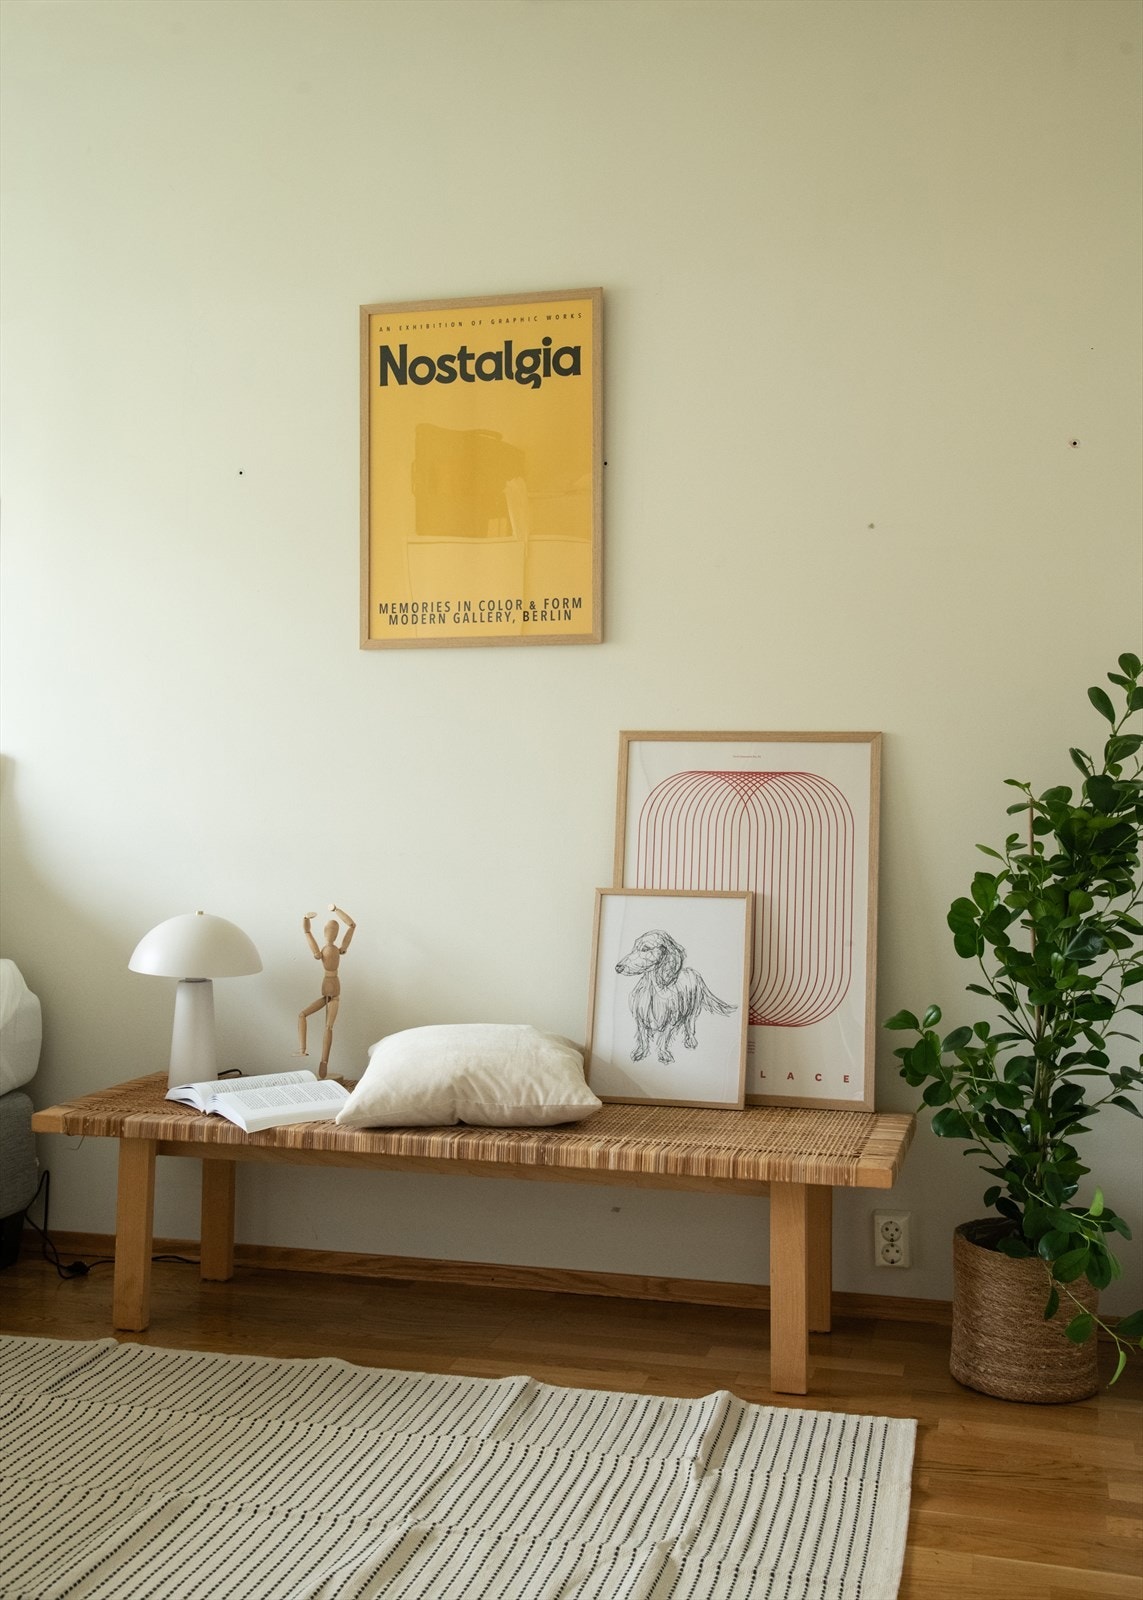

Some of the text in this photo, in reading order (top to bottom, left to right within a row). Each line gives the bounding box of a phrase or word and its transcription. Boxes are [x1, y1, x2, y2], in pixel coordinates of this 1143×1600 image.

[399, 321, 463, 331] EXHIBITION
[490, 315, 538, 325] GRAPHIC
[546, 312, 582, 321] WORKS
[379, 336, 581, 389] Nostalgia
[379, 597, 582, 614] MEMORIES IN COLOR & FORM
[388, 609, 572, 625] MODERN GALLERY, BERLIN
